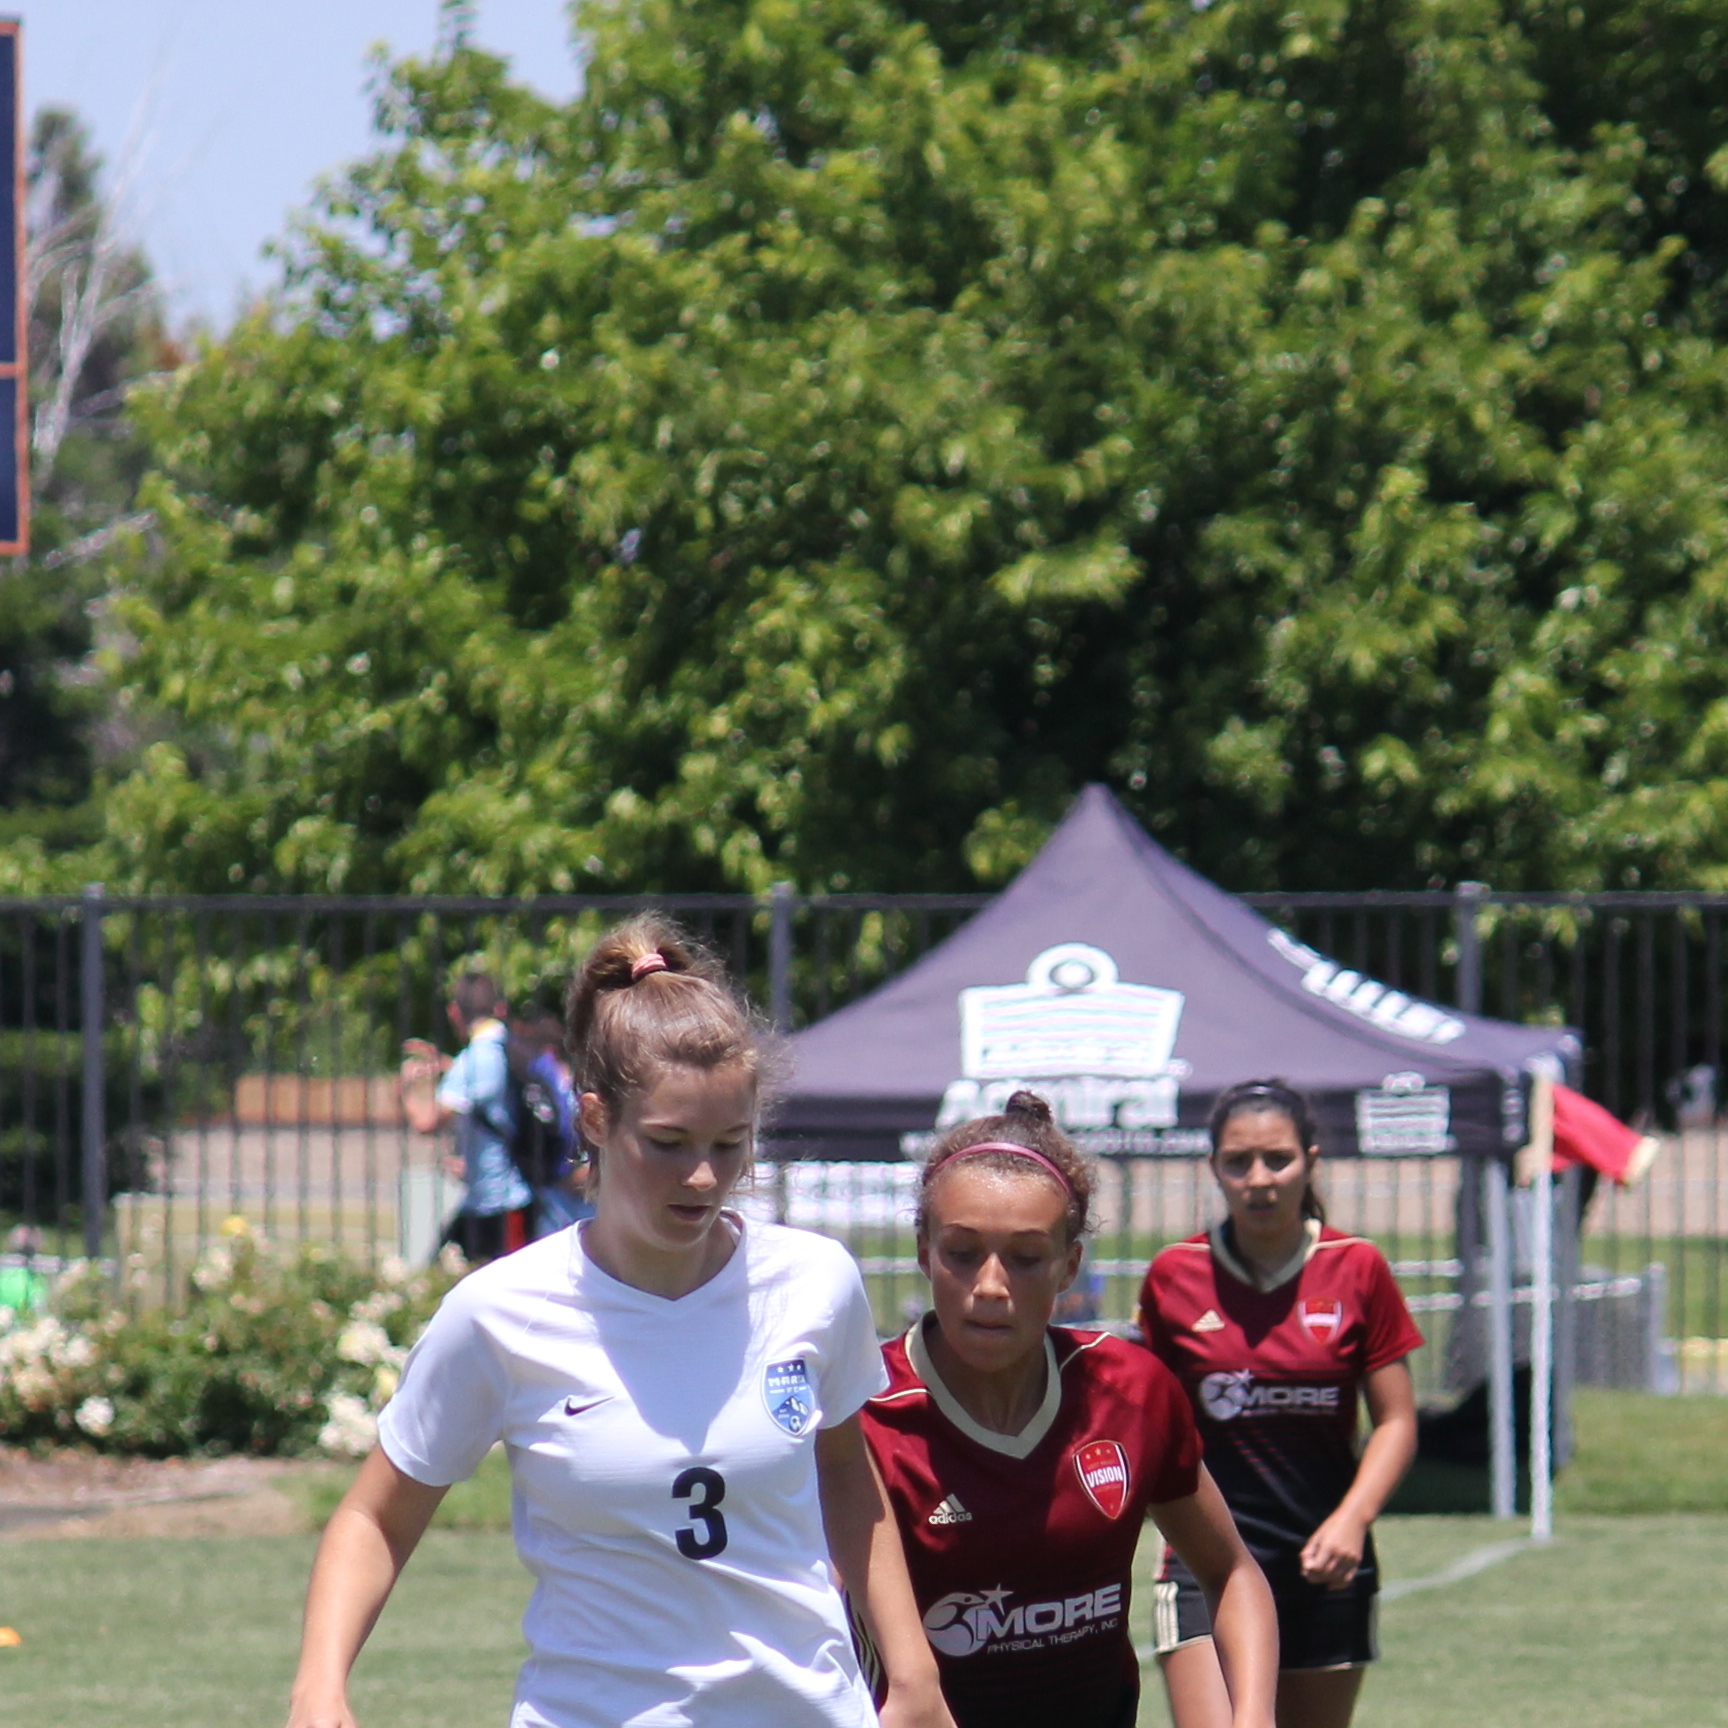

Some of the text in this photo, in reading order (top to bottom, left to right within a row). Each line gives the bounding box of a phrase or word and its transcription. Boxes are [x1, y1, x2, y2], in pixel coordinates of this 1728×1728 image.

[1085, 1465, 1124, 1489] VISION
[672, 1466, 728, 1560] 3
[928, 1511, 973, 1525] adidas
[976, 1582, 1122, 1642] MORE
[987, 1637, 1045, 1654] PHYSICAL
[1048, 1624, 1098, 1646] THERAPY,
